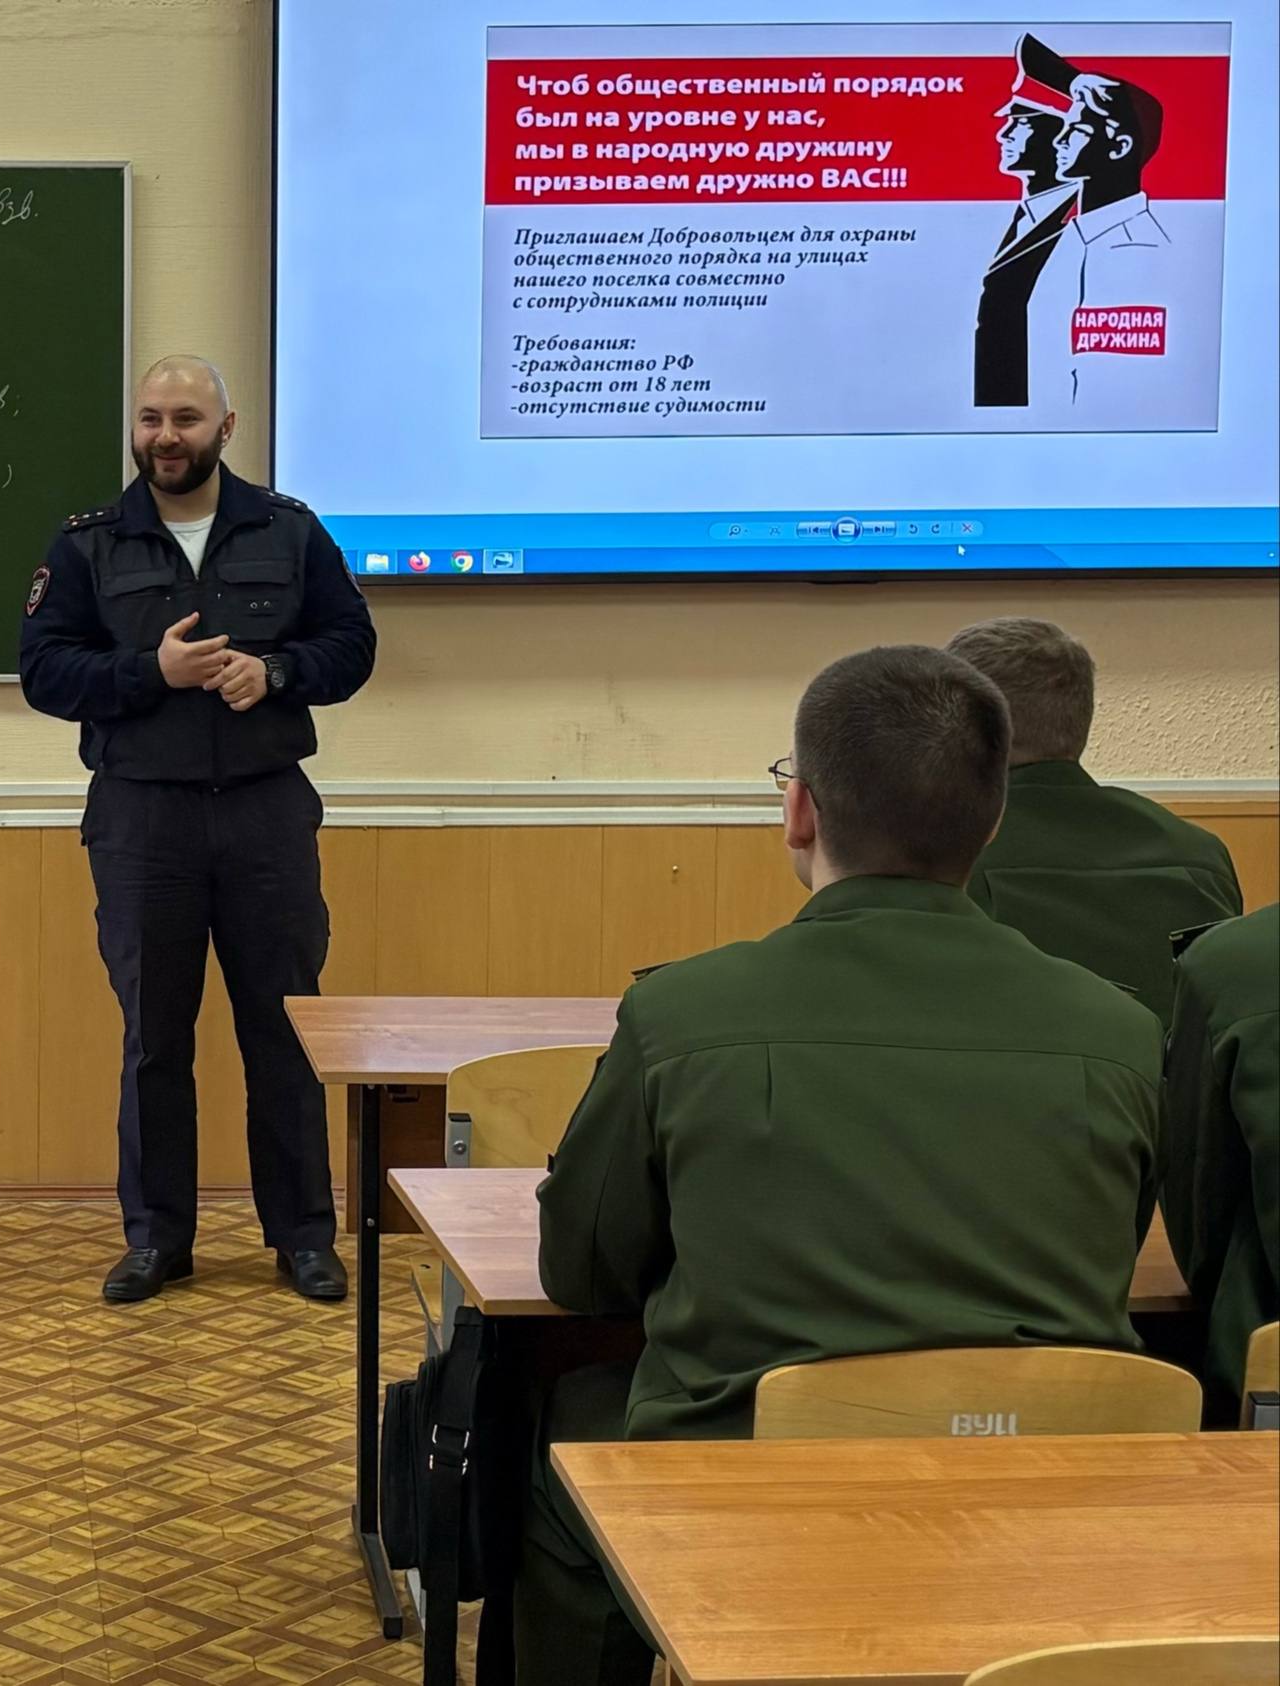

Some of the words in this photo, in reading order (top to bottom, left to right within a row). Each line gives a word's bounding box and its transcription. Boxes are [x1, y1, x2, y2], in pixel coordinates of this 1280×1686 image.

[517, 75, 590, 96] Чтоб
[596, 72, 826, 98] общественный
[832, 76, 964, 97] порядок
[516, 107, 578, 127] был
[585, 110, 619, 127] на
[628, 110, 737, 132] уровне
[744, 110, 762, 131] у
[767, 109, 826, 128] нас,
[516, 143, 564, 159] мы
[571, 143, 589, 159] в
[596, 142, 750, 163] народную
[756, 139, 893, 163] дружину
[515, 174, 690, 196] призываем
[696, 172, 815, 195] дружно
[821, 168, 908, 189] ВАС!!!
[514, 228, 645, 247] Приглашаем
[648, 227, 794, 247] Добровольцем
[800, 225, 835, 242] для
[839, 227, 918, 245] охраны
[514, 249, 673, 269] общественного
[678, 249, 762, 268] порядка
[767, 250, 792, 265] на
[794, 249, 869, 268] улицах
[513, 273, 588, 290] нашего
[592, 272, 671, 289] поселка
[675, 271, 785, 287] совместно
[513, 296, 522, 309] с
[526, 292, 678, 313] сотрудниками
[682, 293, 768, 311] полиции
[1075, 311, 1164, 330] НАРОДНАЯ
[513, 334, 636, 354] Требования:
[1076, 332, 1161, 351] ДРУЖИНА
[511, 356, 657, 376] -гражданство
[662, 354, 695, 371] РФ
[511, 379, 604, 398] -возраст
[609, 379, 638, 393] от
[645, 376, 667, 394] 18
[671, 379, 712, 393] лет
[510, 400, 651, 418] -отсутствие
[654, 396, 767, 417] судимости
